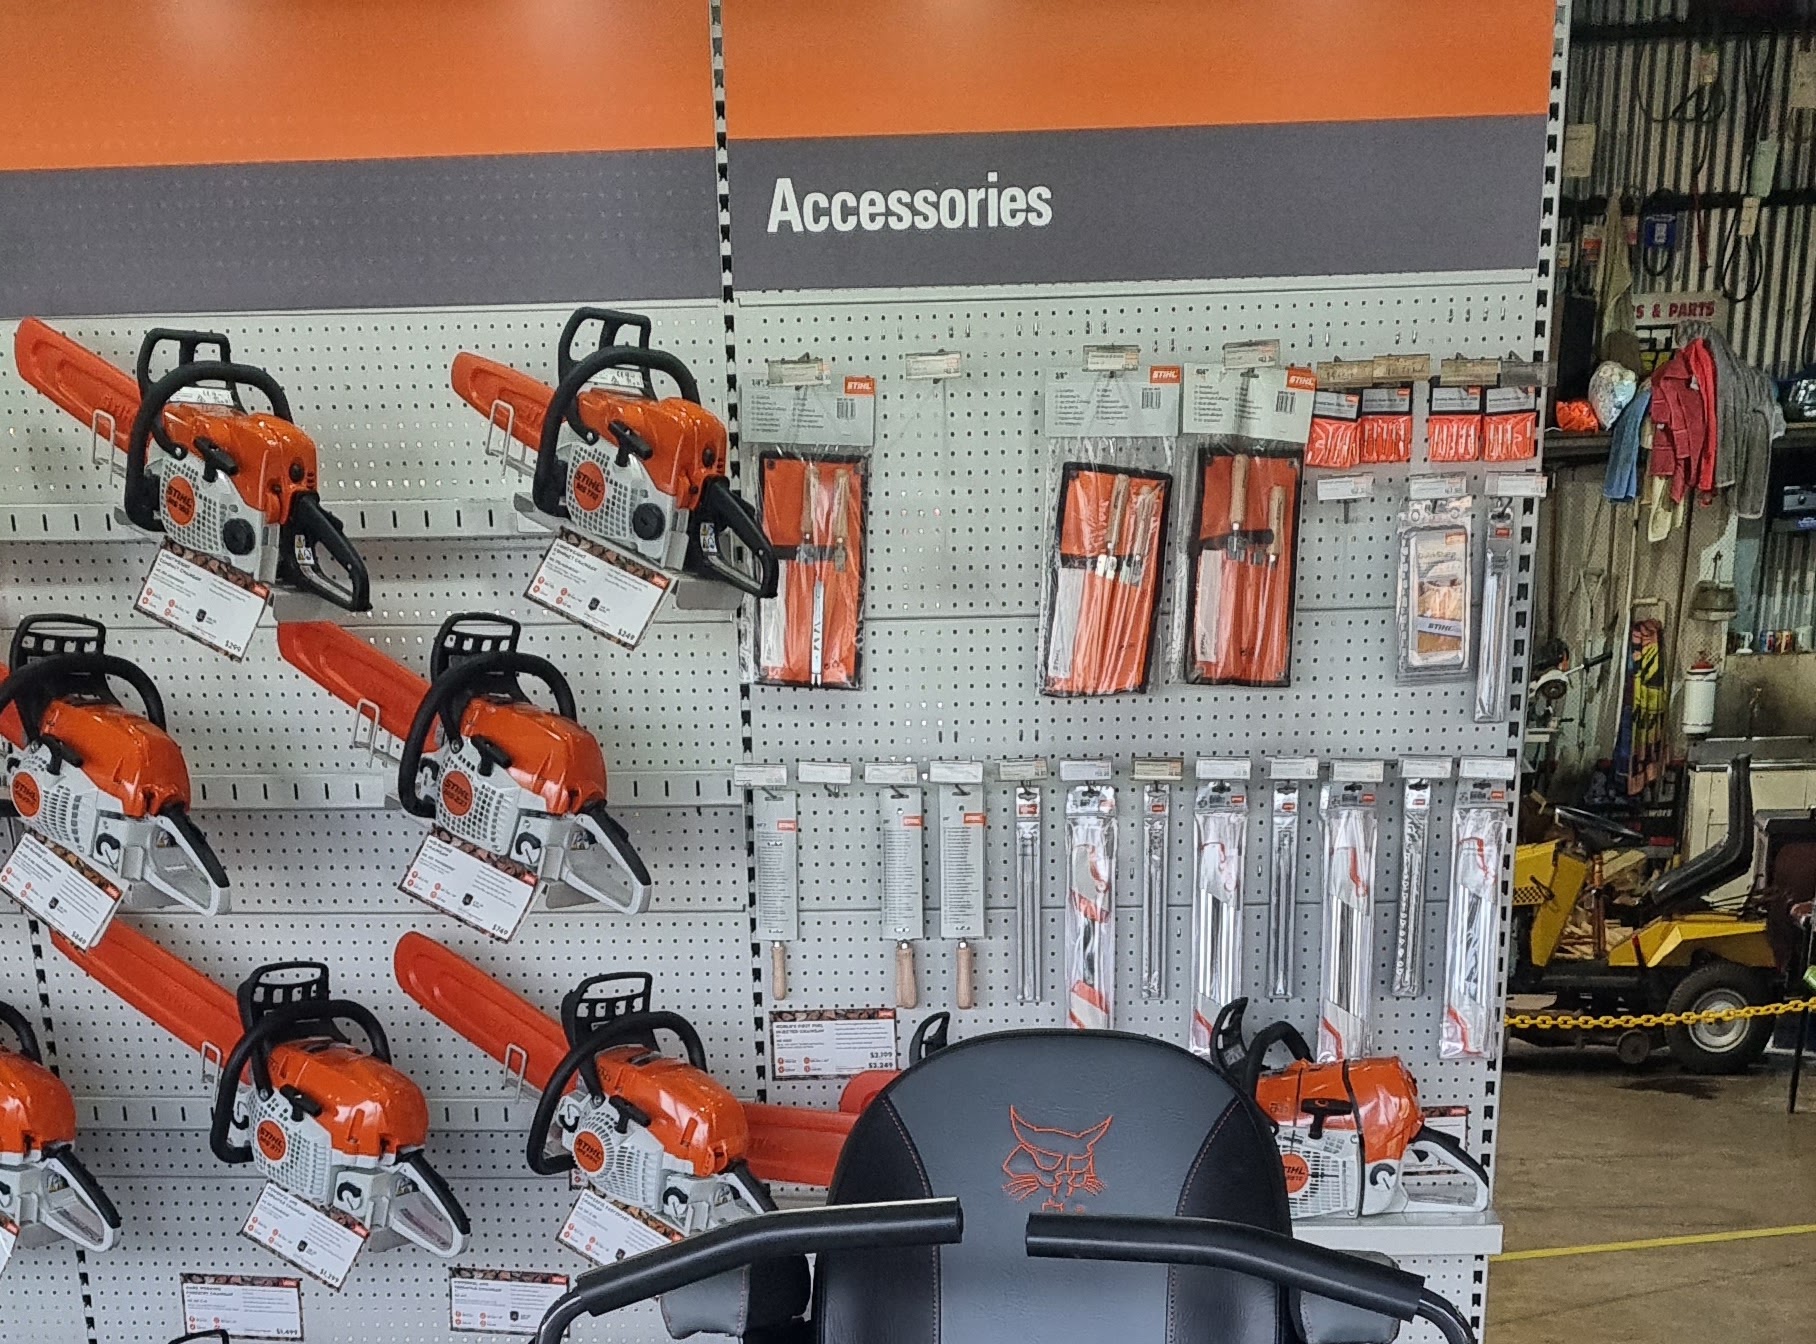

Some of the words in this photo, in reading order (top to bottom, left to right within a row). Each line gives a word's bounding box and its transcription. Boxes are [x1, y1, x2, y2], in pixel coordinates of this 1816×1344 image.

[767, 171, 1053, 233] Accessories
[1652, 303, 1661, 319] &
[1668, 300, 1715, 318] PARTS
[1152, 370, 1178, 379] STIHL
[1290, 375, 1314, 386] STIHL
[847, 381, 872, 390] STIHL
[575, 470, 601, 494] STIHL
[491, 923, 509, 936] $749
[1284, 1165, 1305, 1175] TIHL
